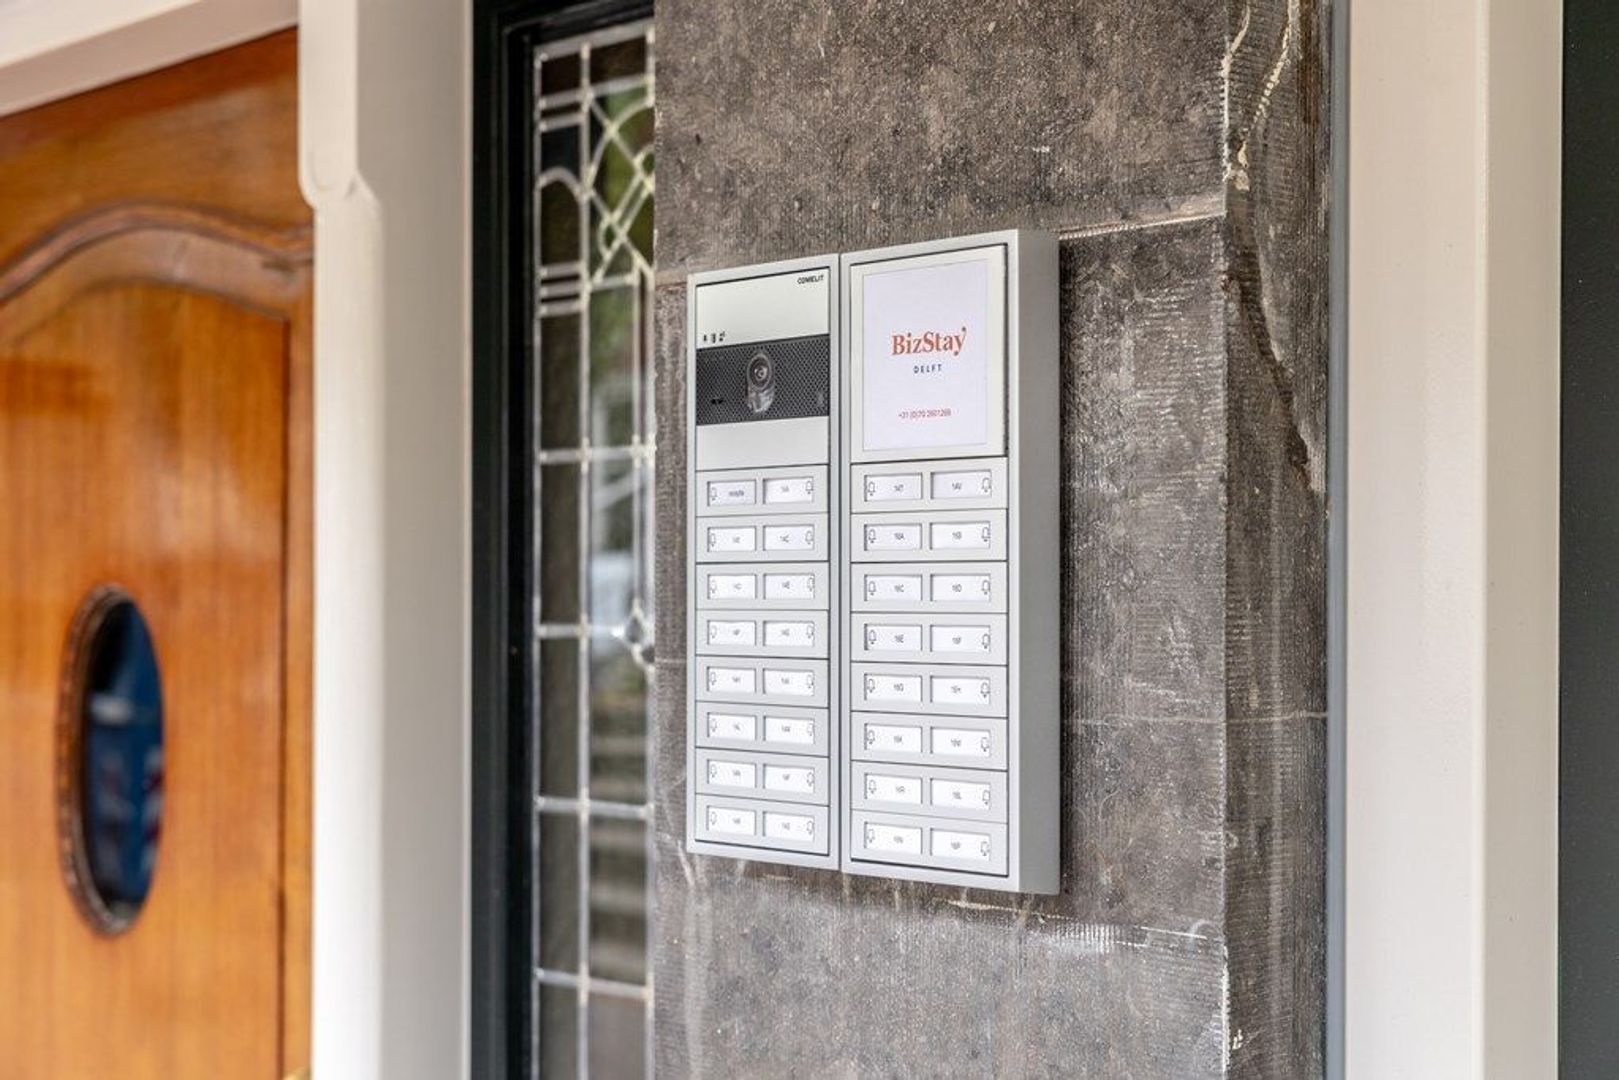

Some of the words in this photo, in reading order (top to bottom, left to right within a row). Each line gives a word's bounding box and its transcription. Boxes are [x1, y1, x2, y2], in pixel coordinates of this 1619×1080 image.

[797, 274, 824, 285] COMELIT
[892, 326, 967, 356] BizStay
[913, 363, 943, 374] DELFT
